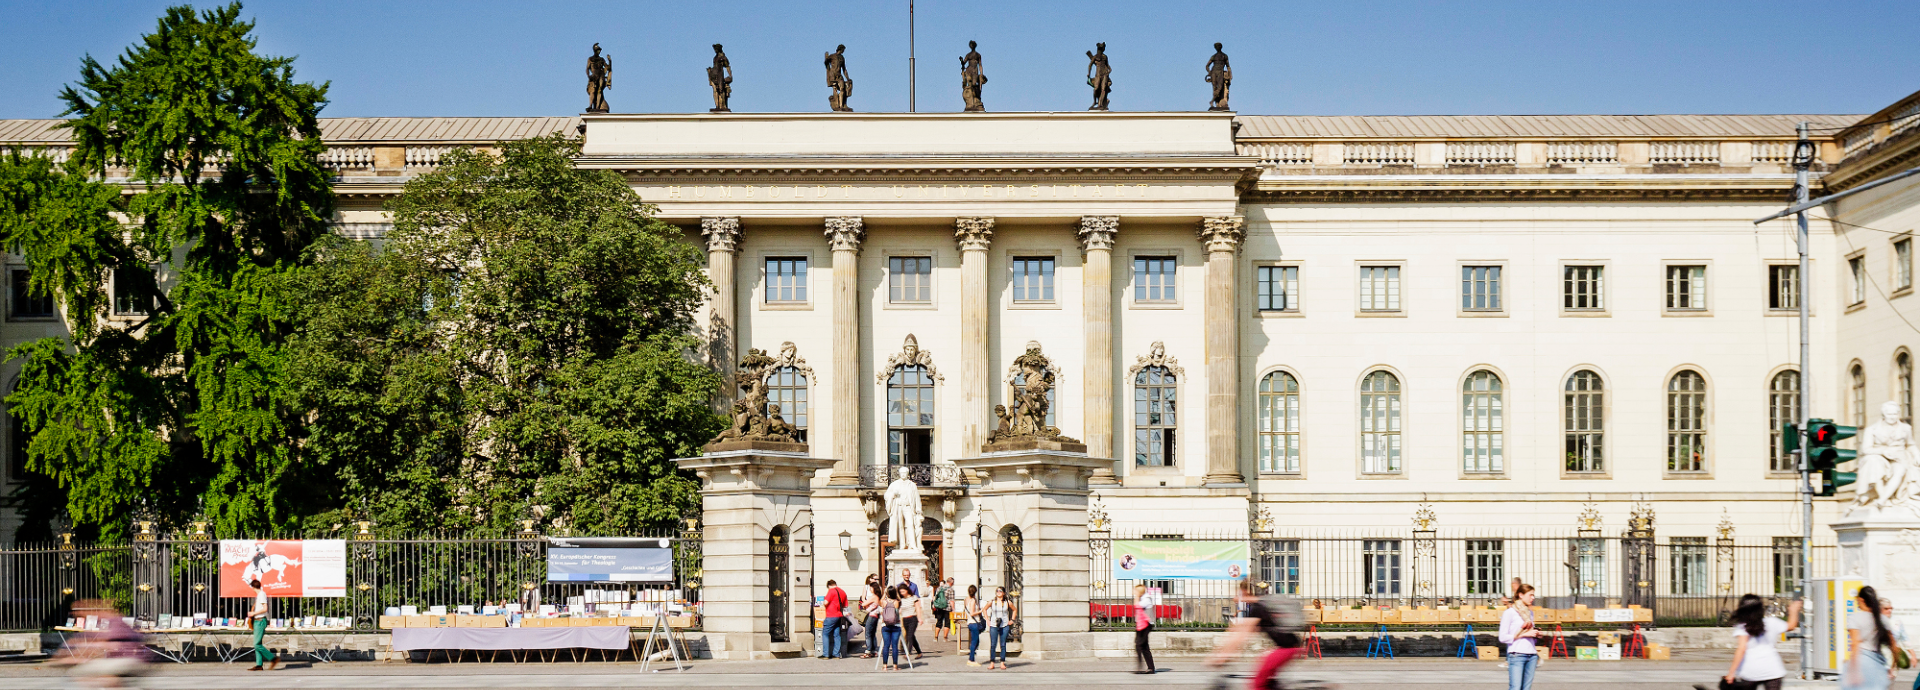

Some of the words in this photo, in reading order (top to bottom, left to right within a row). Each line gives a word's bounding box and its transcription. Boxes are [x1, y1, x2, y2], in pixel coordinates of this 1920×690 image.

[669, 185, 852, 198] HUMBOLDT
[893, 184, 1148, 198] UNIVERSITAET
[1141, 545, 1194, 555] humboldt
[1165, 554, 1200, 562] kinder
